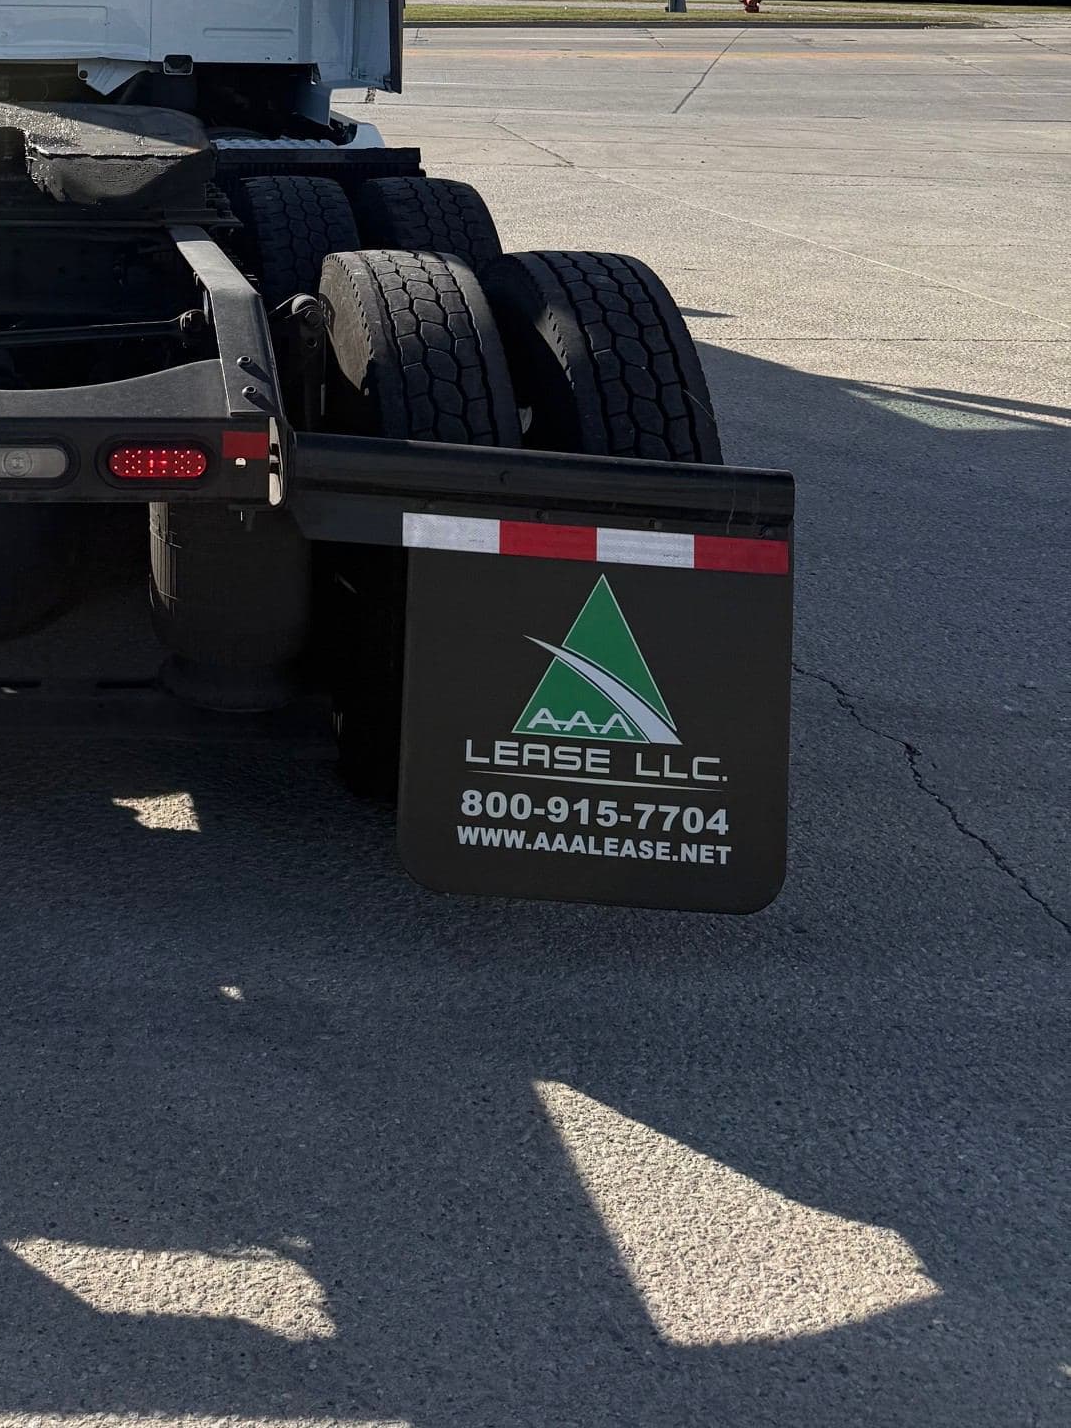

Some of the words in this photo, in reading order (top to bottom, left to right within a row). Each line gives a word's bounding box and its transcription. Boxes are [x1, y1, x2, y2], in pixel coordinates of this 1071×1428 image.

[526, 707, 635, 737] AAA
[465, 739, 610, 774] LEASE
[635, 752, 728, 782] LLC.
[460, 789, 729, 836] 800-915-7704
[457, 825, 732, 865] WWW.AAALEASE.NET
